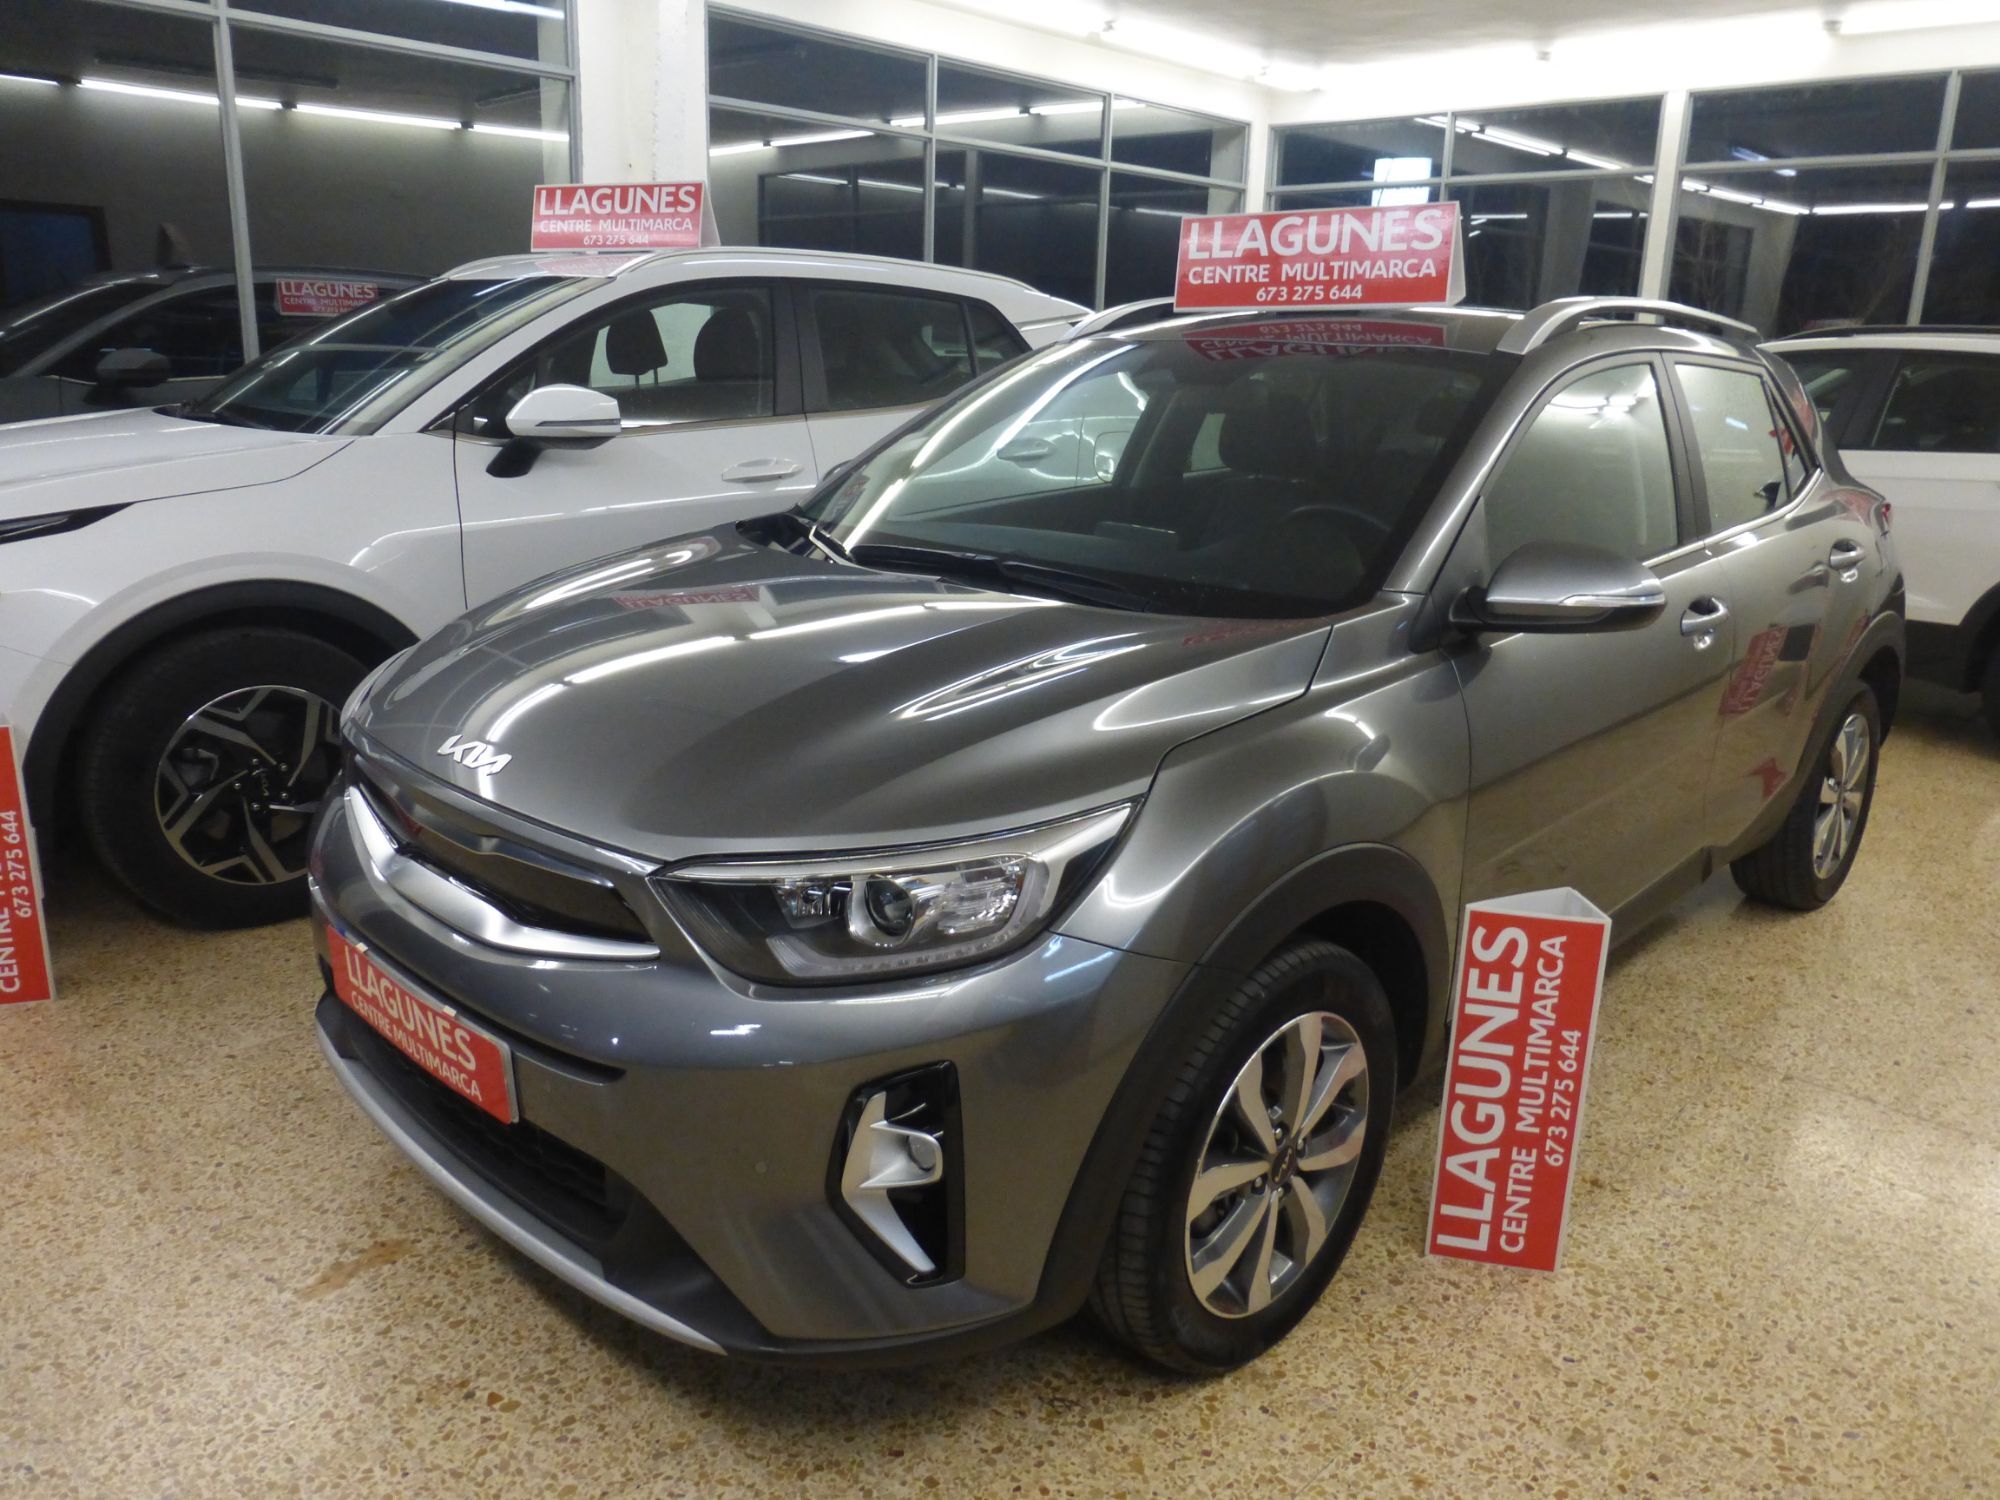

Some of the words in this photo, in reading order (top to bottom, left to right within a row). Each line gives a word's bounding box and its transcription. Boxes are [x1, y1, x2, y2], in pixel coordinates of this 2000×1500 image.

[539, 185, 696, 216] LLAGUNES
[539, 219, 592, 233] CENTRE
[599, 217, 693, 233] MULTIMARCA
[583, 235, 603, 245] 673
[606, 234, 626, 245] 275
[628, 233, 649, 244] 644
[1187, 208, 1444, 261] LLAGUNES
[280, 280, 376, 299] LLAGUNES
[1188, 263, 1270, 285] CENTRE
[1281, 258, 1437, 282] MULTIMARCA
[1256, 286, 1287, 302] 673
[1292, 284, 1324, 301] 275
[1329, 283, 1363, 300] 644
[437, 734, 513, 776] KIA
[0, 810, 20, 845] 644
[6, 849, 23, 881] 275
[12, 885, 32, 918] 673
[344, 945, 476, 1071] LLAGUNES
[351, 990, 393, 1037] CENTRE
[393, 1029, 483, 1102] MULTIMARCA
[1516, 935, 1567, 1133] MULTIMARCA
[1558, 1029, 1582, 1073] 644
[1436, 925, 1529, 1252] LLAGUNES
[1551, 1079, 1574, 1121] 275
[1544, 1126, 1568, 1167] 673
[1500, 1146, 1537, 1253] CENTRE
